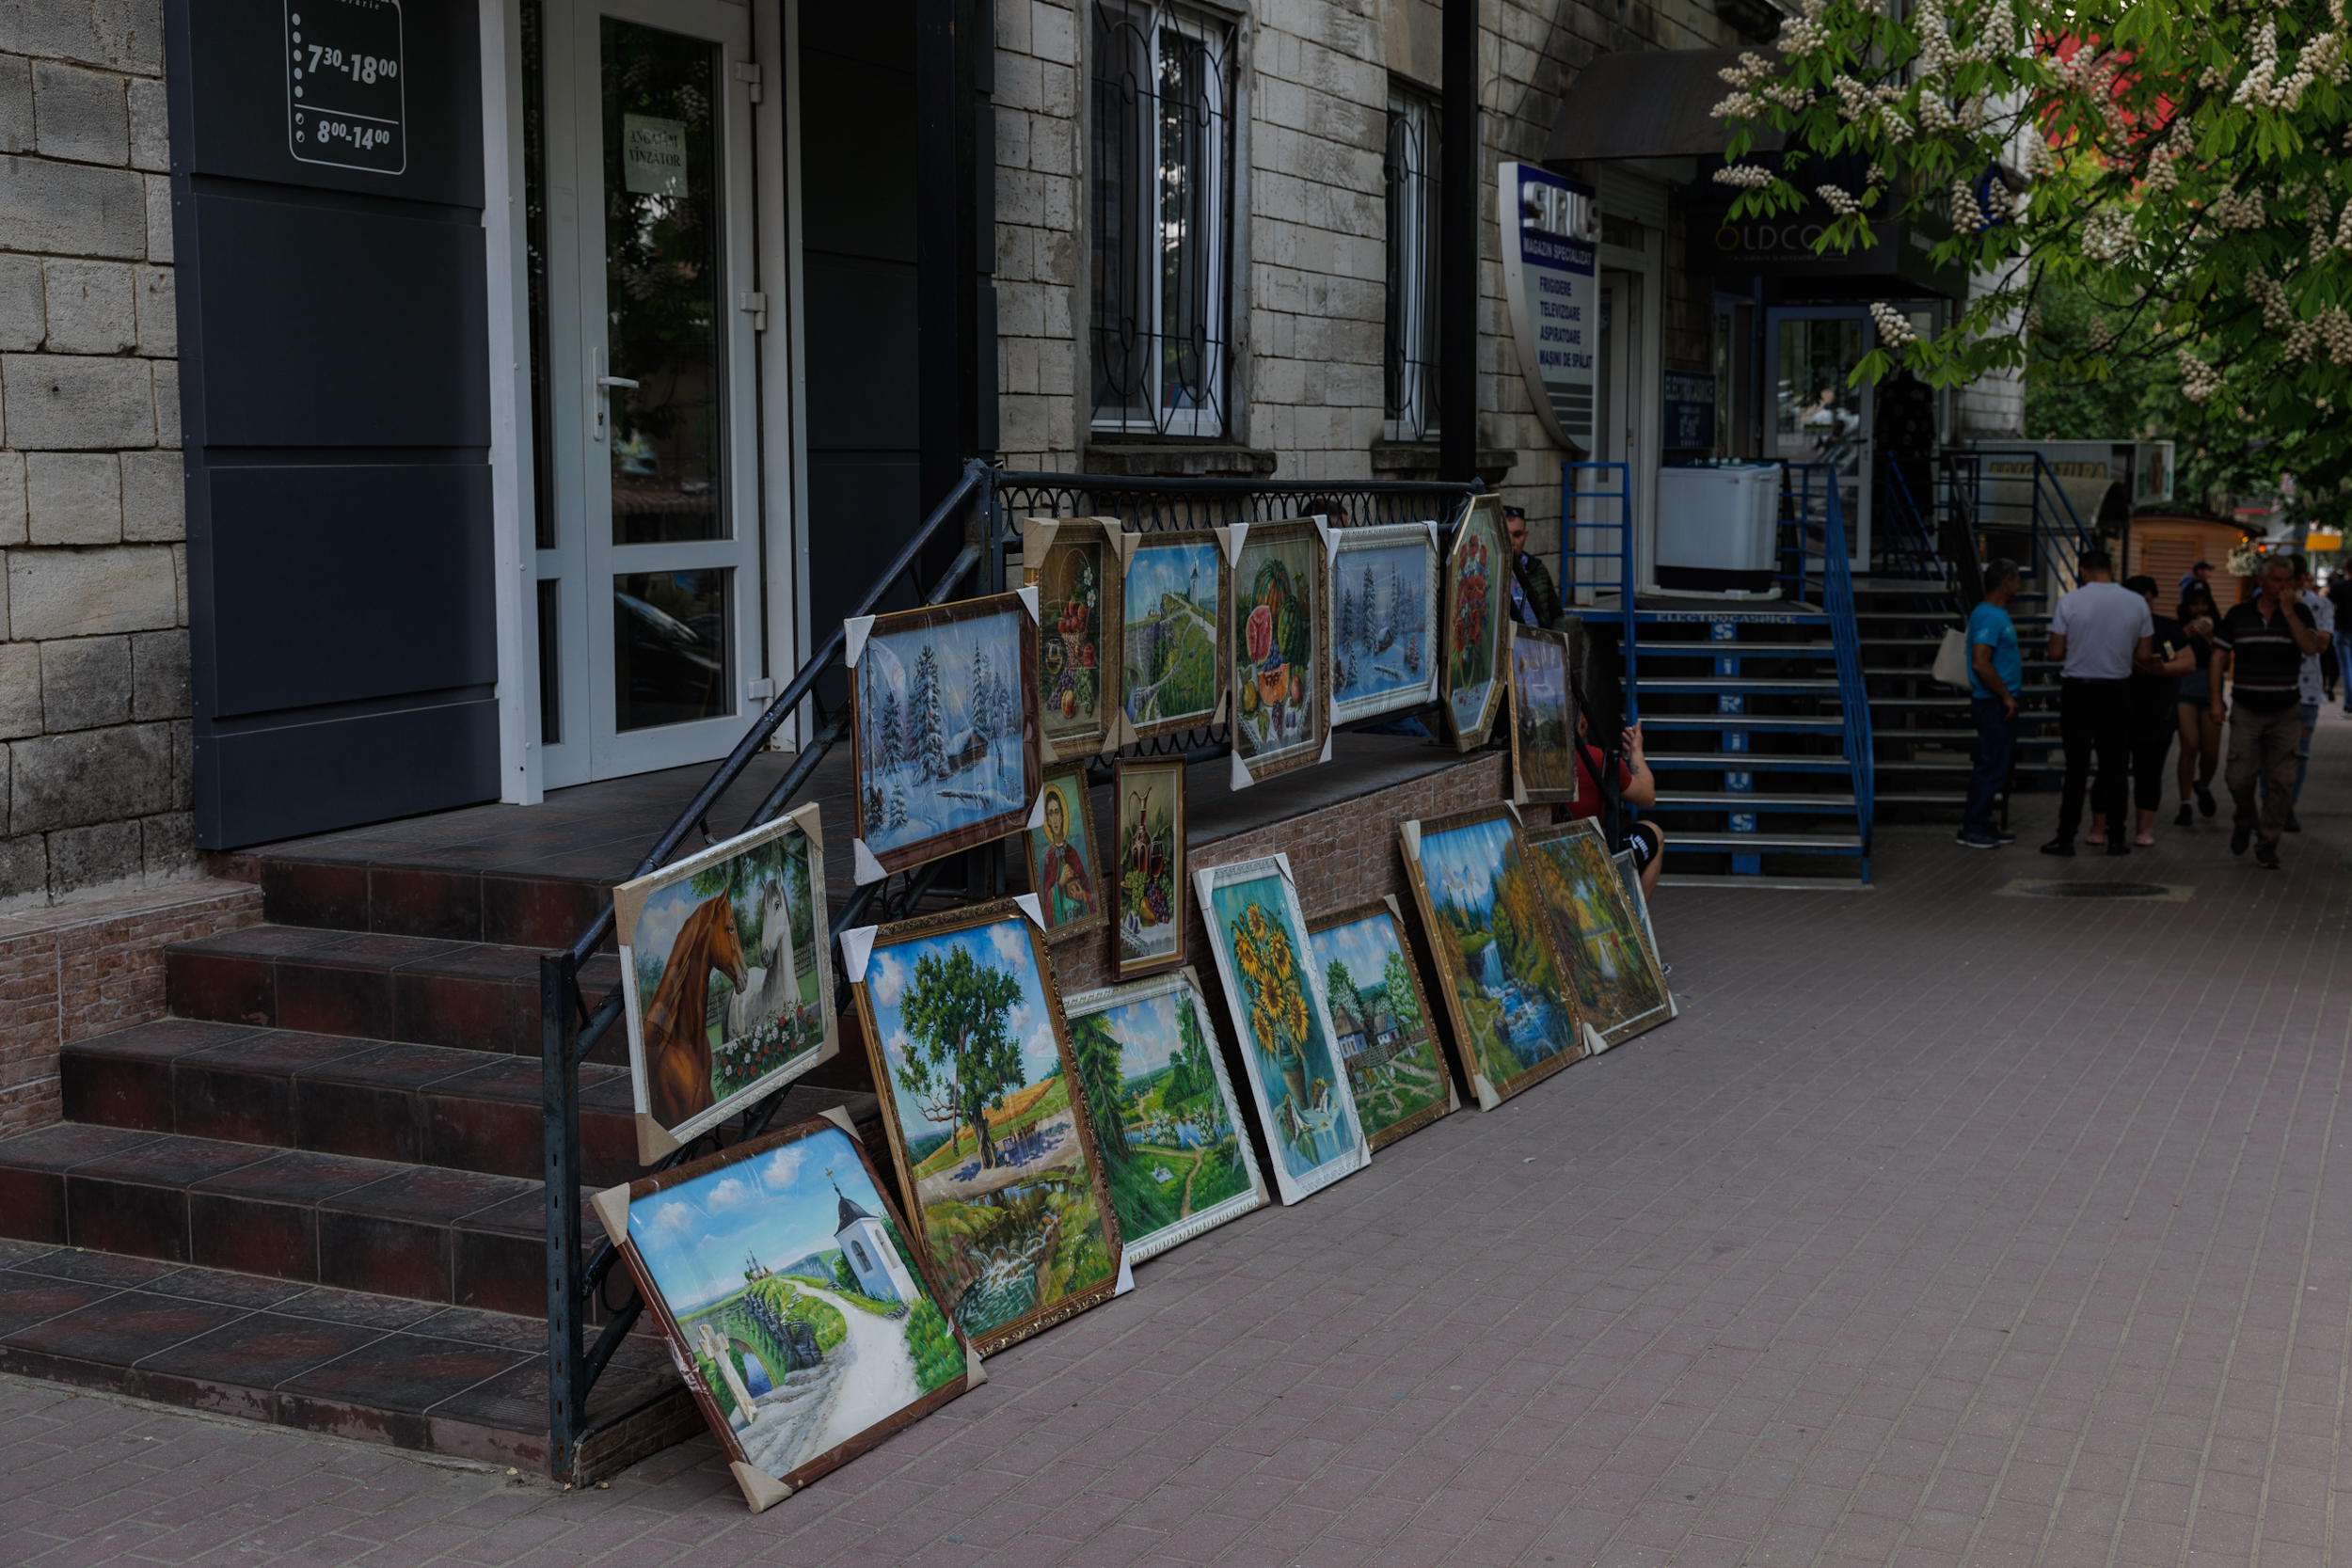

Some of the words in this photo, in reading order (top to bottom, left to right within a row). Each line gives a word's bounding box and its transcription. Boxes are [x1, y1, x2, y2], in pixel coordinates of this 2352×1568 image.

[1523, 181, 1603, 243] SIRIUS
[1523, 237, 1552, 259] MAGAZIN
[1553, 243, 1592, 267] SPECIALIZAT
[1539, 276, 1571, 297] FRIGIDERE
[1539, 300, 1581, 322] TELEVIZOARE
[1539, 325, 1581, 345] ASPIRATOARE
[1563, 351, 1570, 368] DE
[1656, 612, 1797, 625] ELECTROCASNICE
